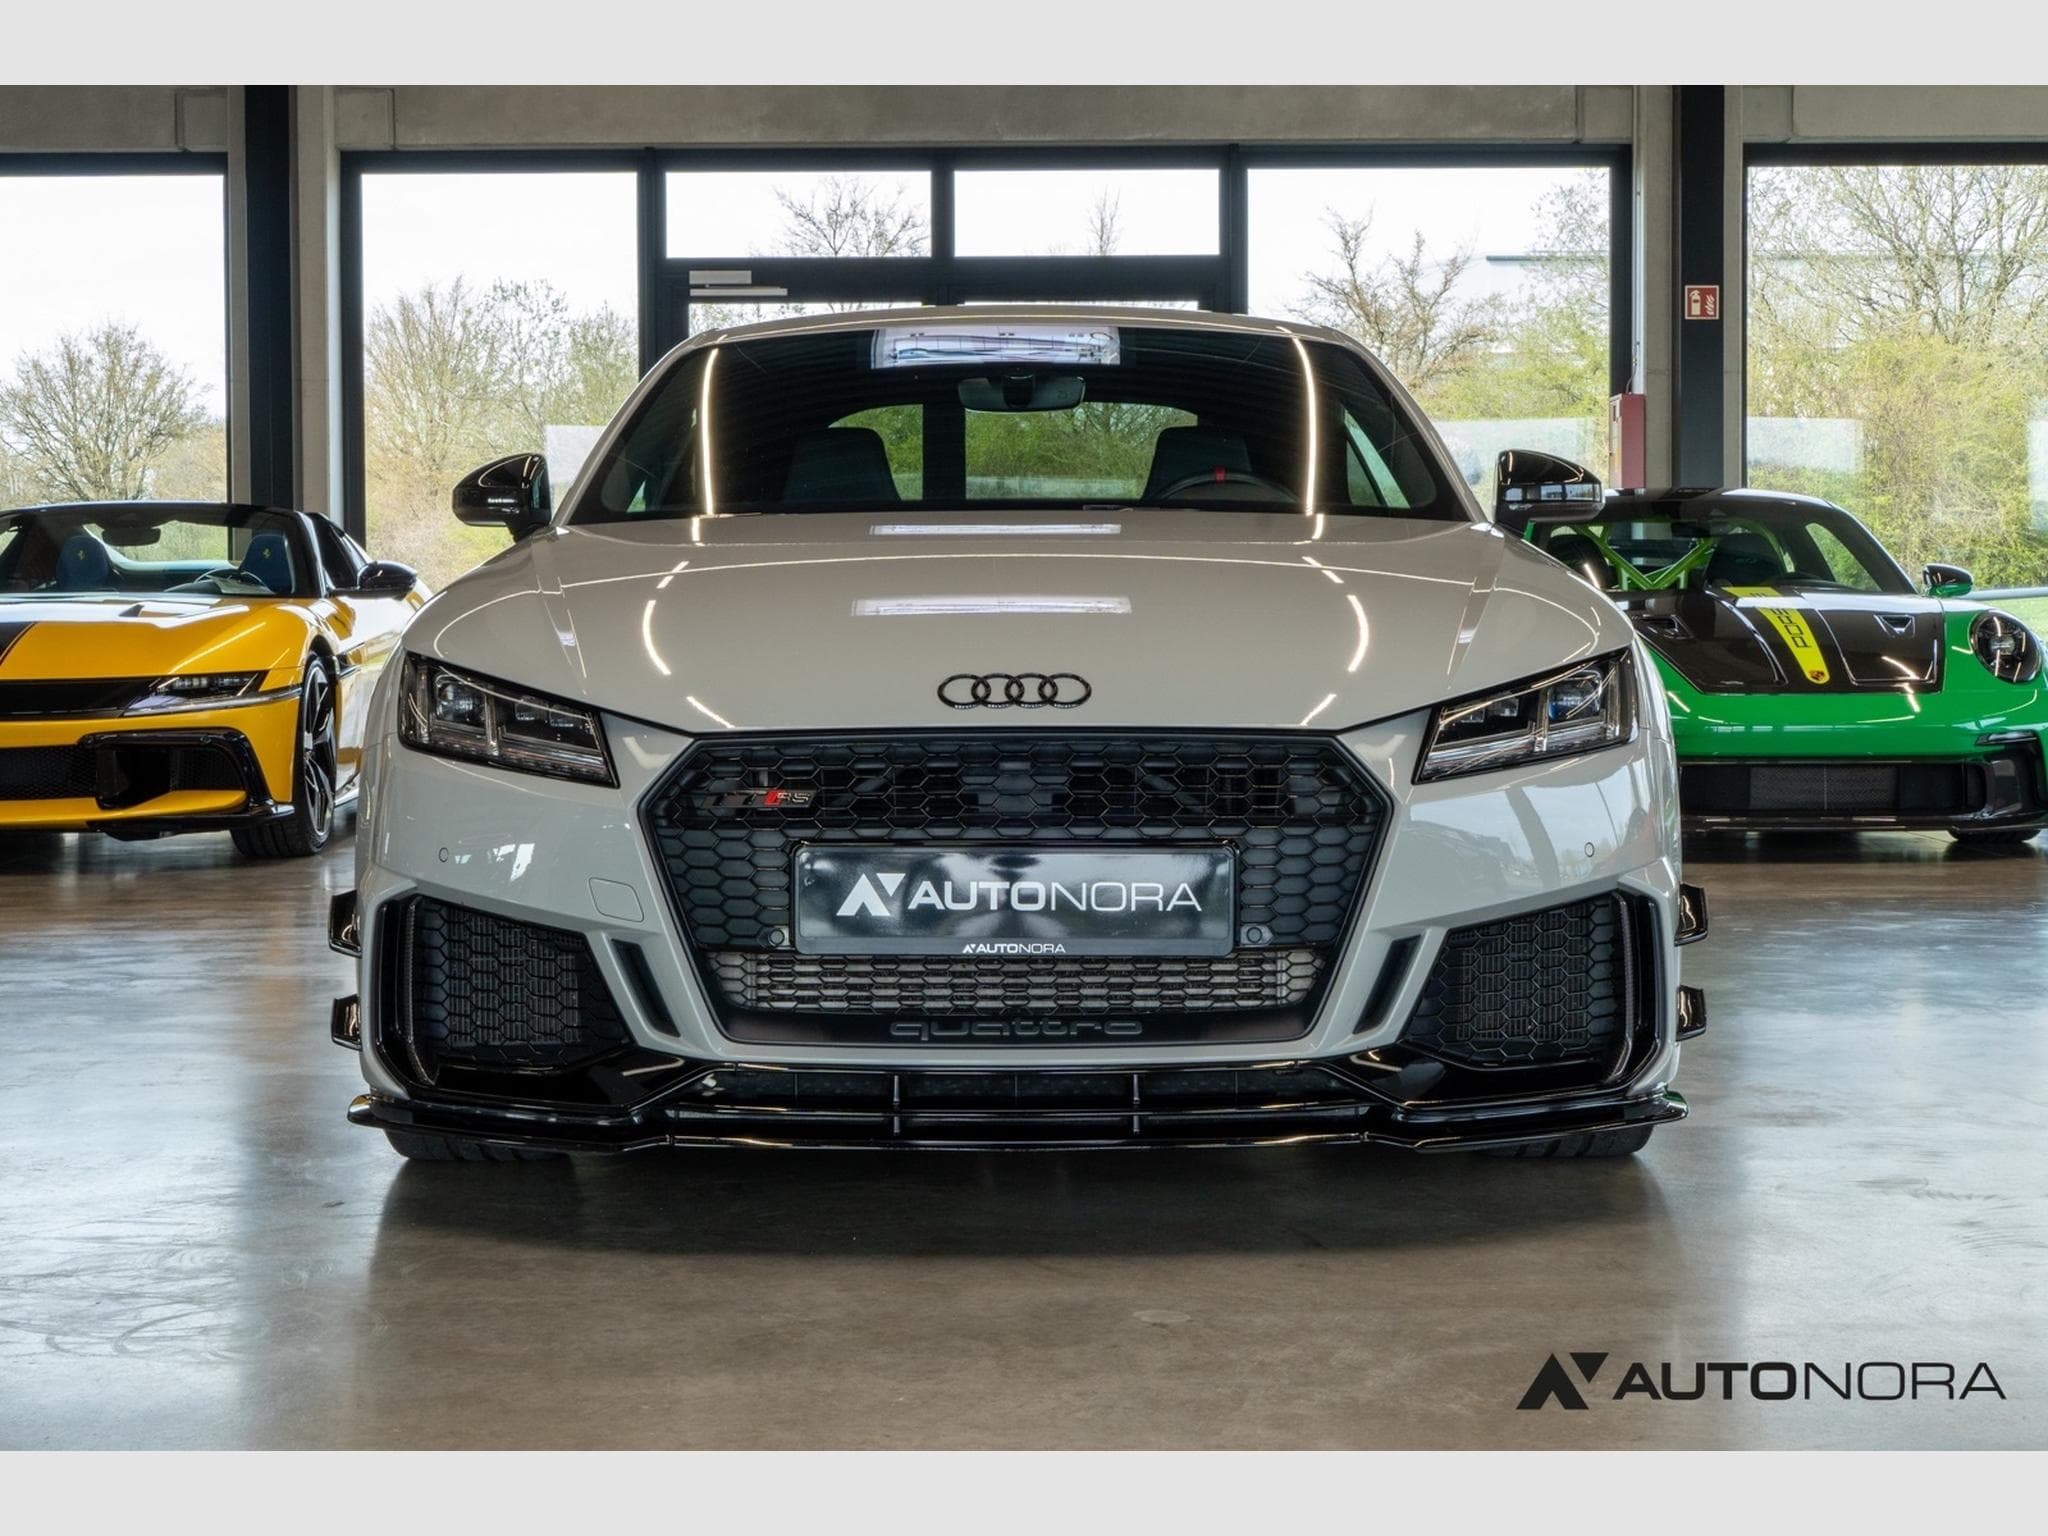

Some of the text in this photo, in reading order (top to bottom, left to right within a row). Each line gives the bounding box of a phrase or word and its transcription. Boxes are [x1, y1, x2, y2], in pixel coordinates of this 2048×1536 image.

[908, 880, 1202, 911] AUTONORA
[976, 943, 1066, 954] AUTONORA
[889, 1018, 1143, 1041] quattro
